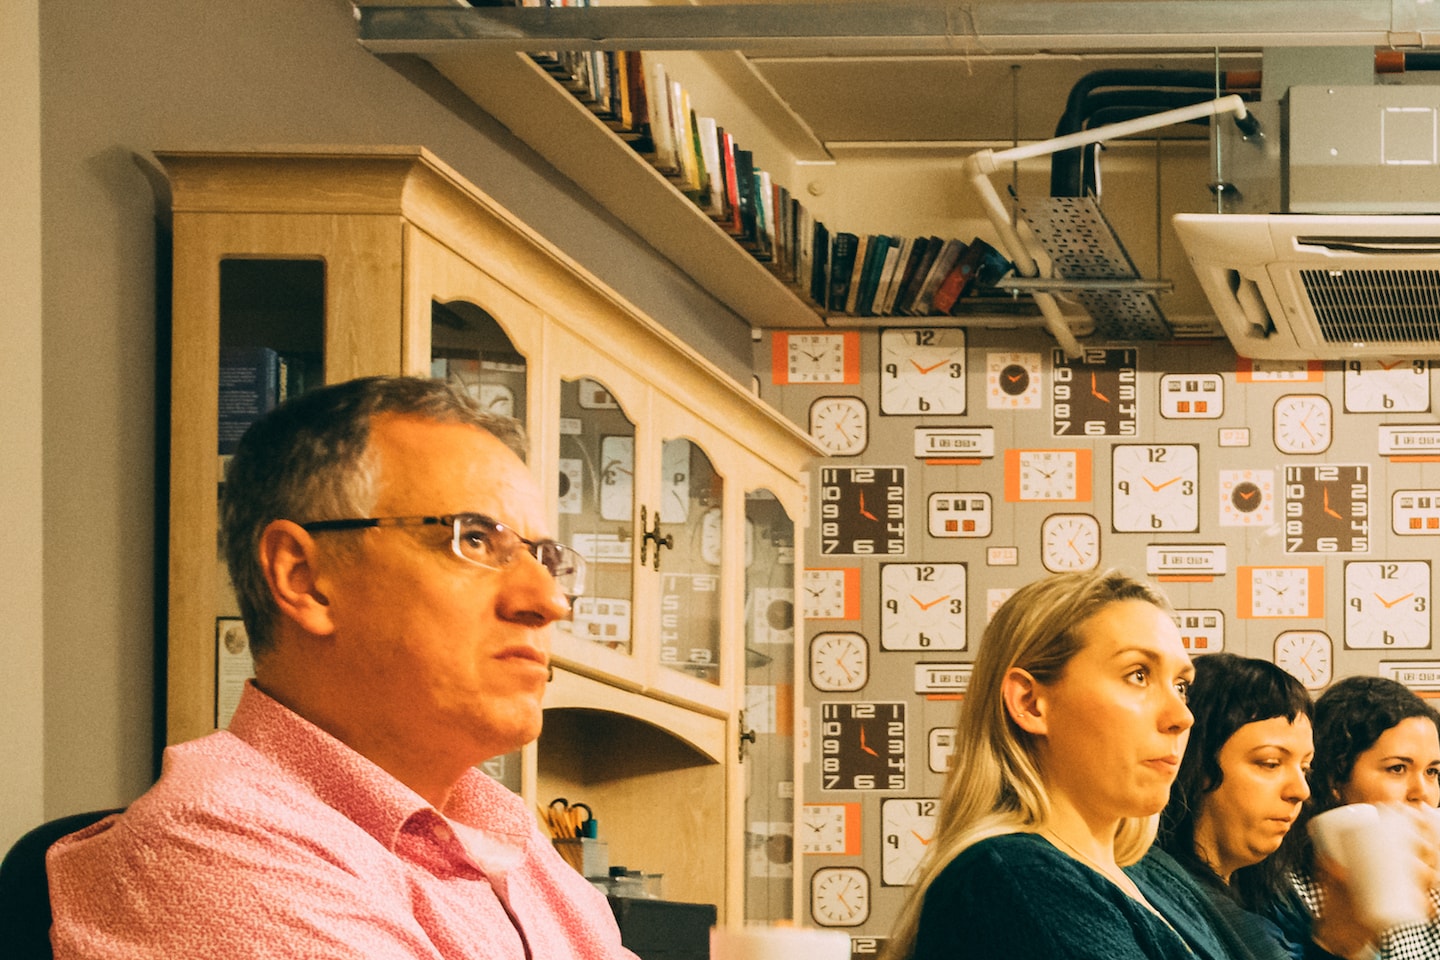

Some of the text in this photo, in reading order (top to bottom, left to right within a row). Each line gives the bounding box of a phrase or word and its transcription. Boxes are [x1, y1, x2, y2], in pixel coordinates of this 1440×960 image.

[915, 331, 934, 346] 12
[886, 364, 897, 378] 9
[950, 364, 962, 378] 3
[1350, 361, 1361, 375] 9
[1413, 359, 1425, 374] 3
[1147, 448, 1166, 462] 12
[823, 469, 837, 483] 11
[851, 469, 874, 483] 12
[1287, 467, 1301, 481] 11
[1315, 467, 1338, 481] 12
[822, 486, 840, 500] 10
[887, 486, 902, 500] 2
[1118, 481, 1129, 495] 9
[1182, 480, 1194, 495] 3
[1286, 484, 1304, 498] 10
[1351, 484, 1366, 498] 2
[823, 504, 838, 518] 9
[887, 504, 902, 518] 3
[1287, 502, 1302, 516] 9
[1351, 502, 1366, 516] 3
[823, 522, 838, 536] 8
[887, 522, 903, 536] 4
[1287, 520, 1302, 534] 8
[1351, 520, 1367, 534] 4
[823, 539, 839, 554] 7
[852, 539, 874, 554] 6
[887, 539, 903, 554] 5
[1287, 537, 1303, 552] 7
[1316, 537, 1338, 552] 6
[1351, 537, 1367, 552] 5
[915, 567, 934, 582] 12
[1379, 565, 1398, 580] 12
[886, 600, 897, 614] 9
[950, 600, 962, 614] 3
[1350, 598, 1361, 612] 9
[1414, 596, 1426, 611] 3
[916, 802, 935, 816] 12
[887, 835, 898, 849] 9
